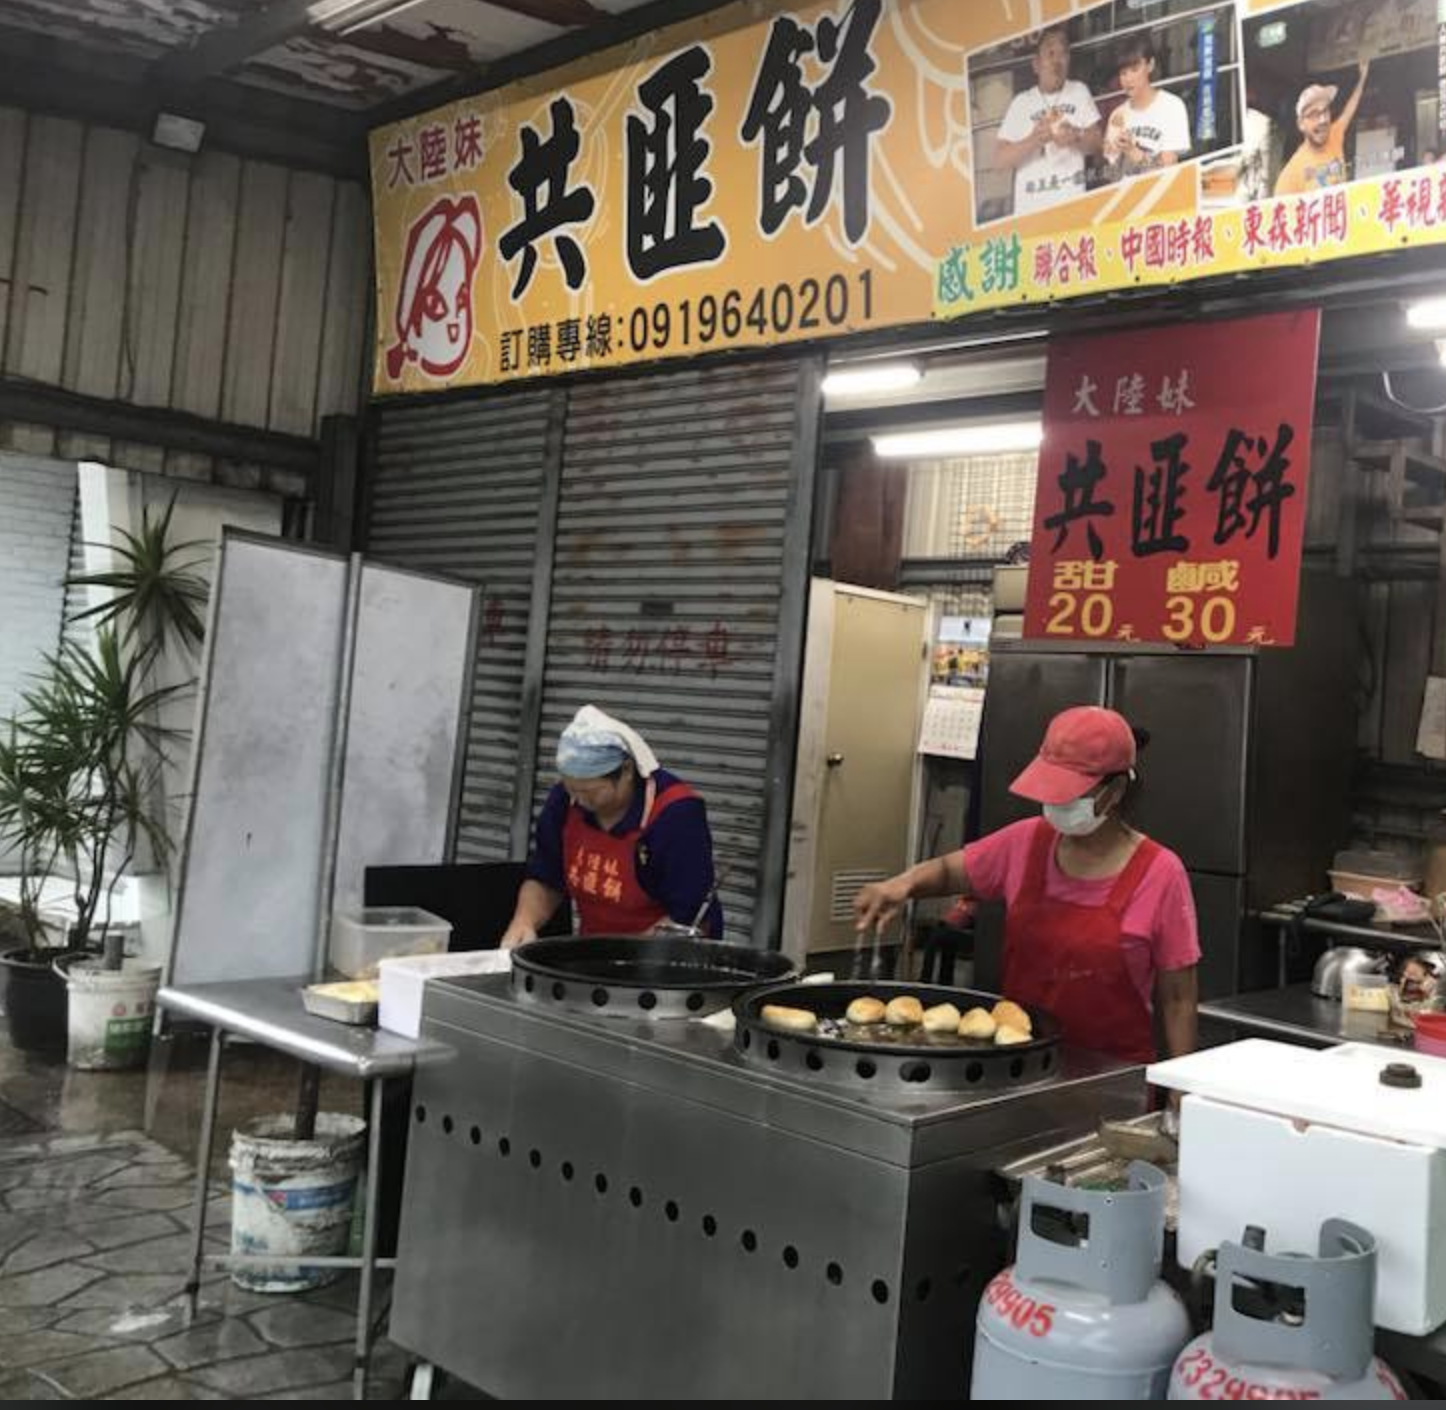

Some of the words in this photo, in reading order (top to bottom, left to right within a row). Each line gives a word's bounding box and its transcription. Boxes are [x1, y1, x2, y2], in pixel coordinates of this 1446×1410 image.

[387, 115, 483, 188] 大陸妹
[499, 0, 891, 300] 共匪餅
[937, 233, 1022, 303] 感謝
[500, 269, 876, 373] 訂購專線:0919640201
[1071, 368, 1197, 416] 大陸妹
[1044, 423, 1295, 561] 共匪餅
[1053, 560, 1119, 590] 甜
[1165, 560, 1241, 594] 鹹
